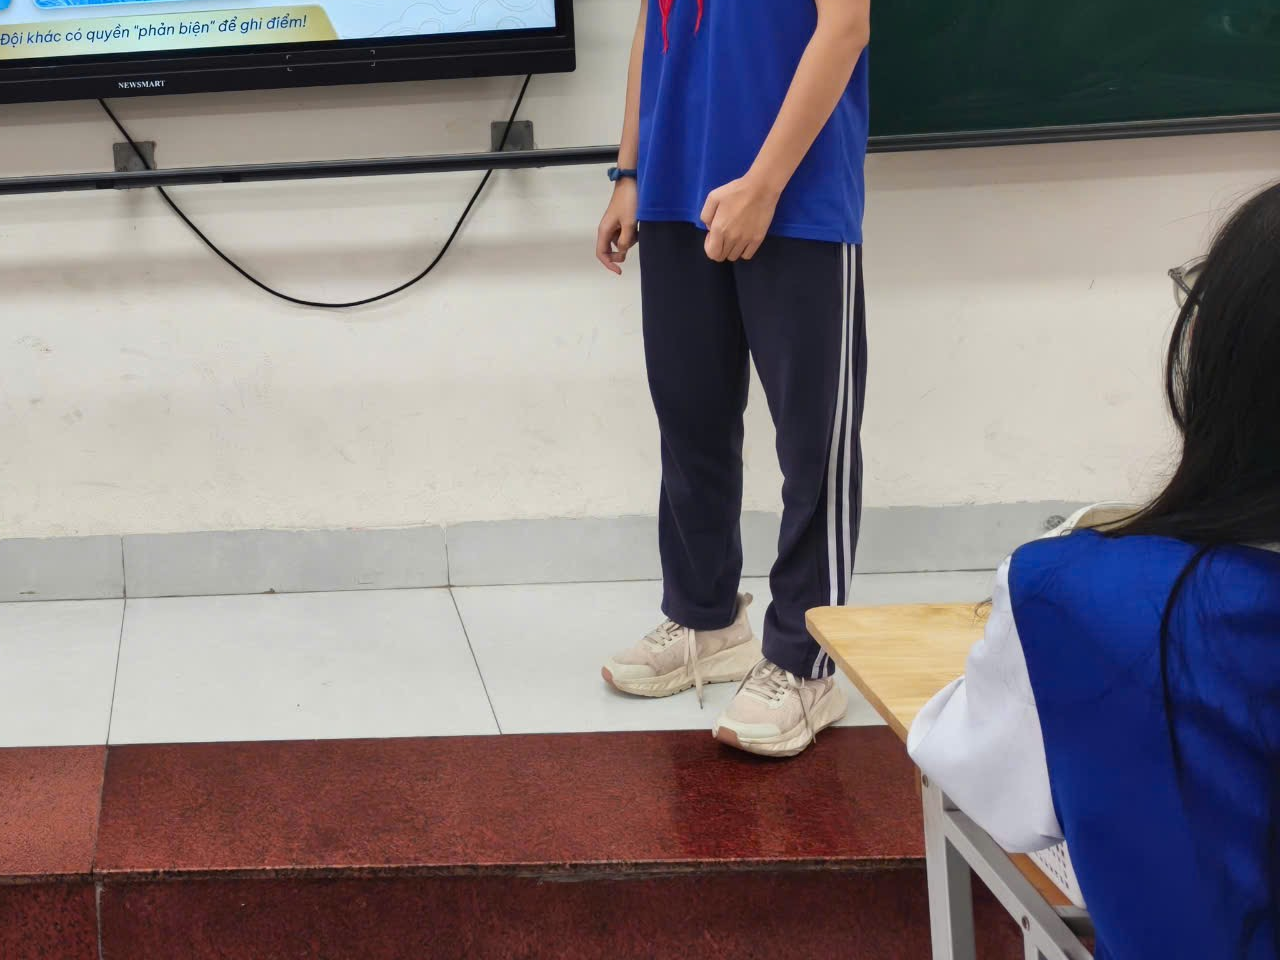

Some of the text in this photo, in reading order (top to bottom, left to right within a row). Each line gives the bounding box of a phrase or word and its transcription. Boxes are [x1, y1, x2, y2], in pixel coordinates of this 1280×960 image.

[26, 30, 62, 44] khác
[65, 28, 82, 41] có
[86, 23, 130, 42] quyền
[218, 16, 238, 32] để
[240, 17, 262, 34] ghi
[266, 12, 307, 29] điểm!
[118, 79, 166, 89] NEWSMART
